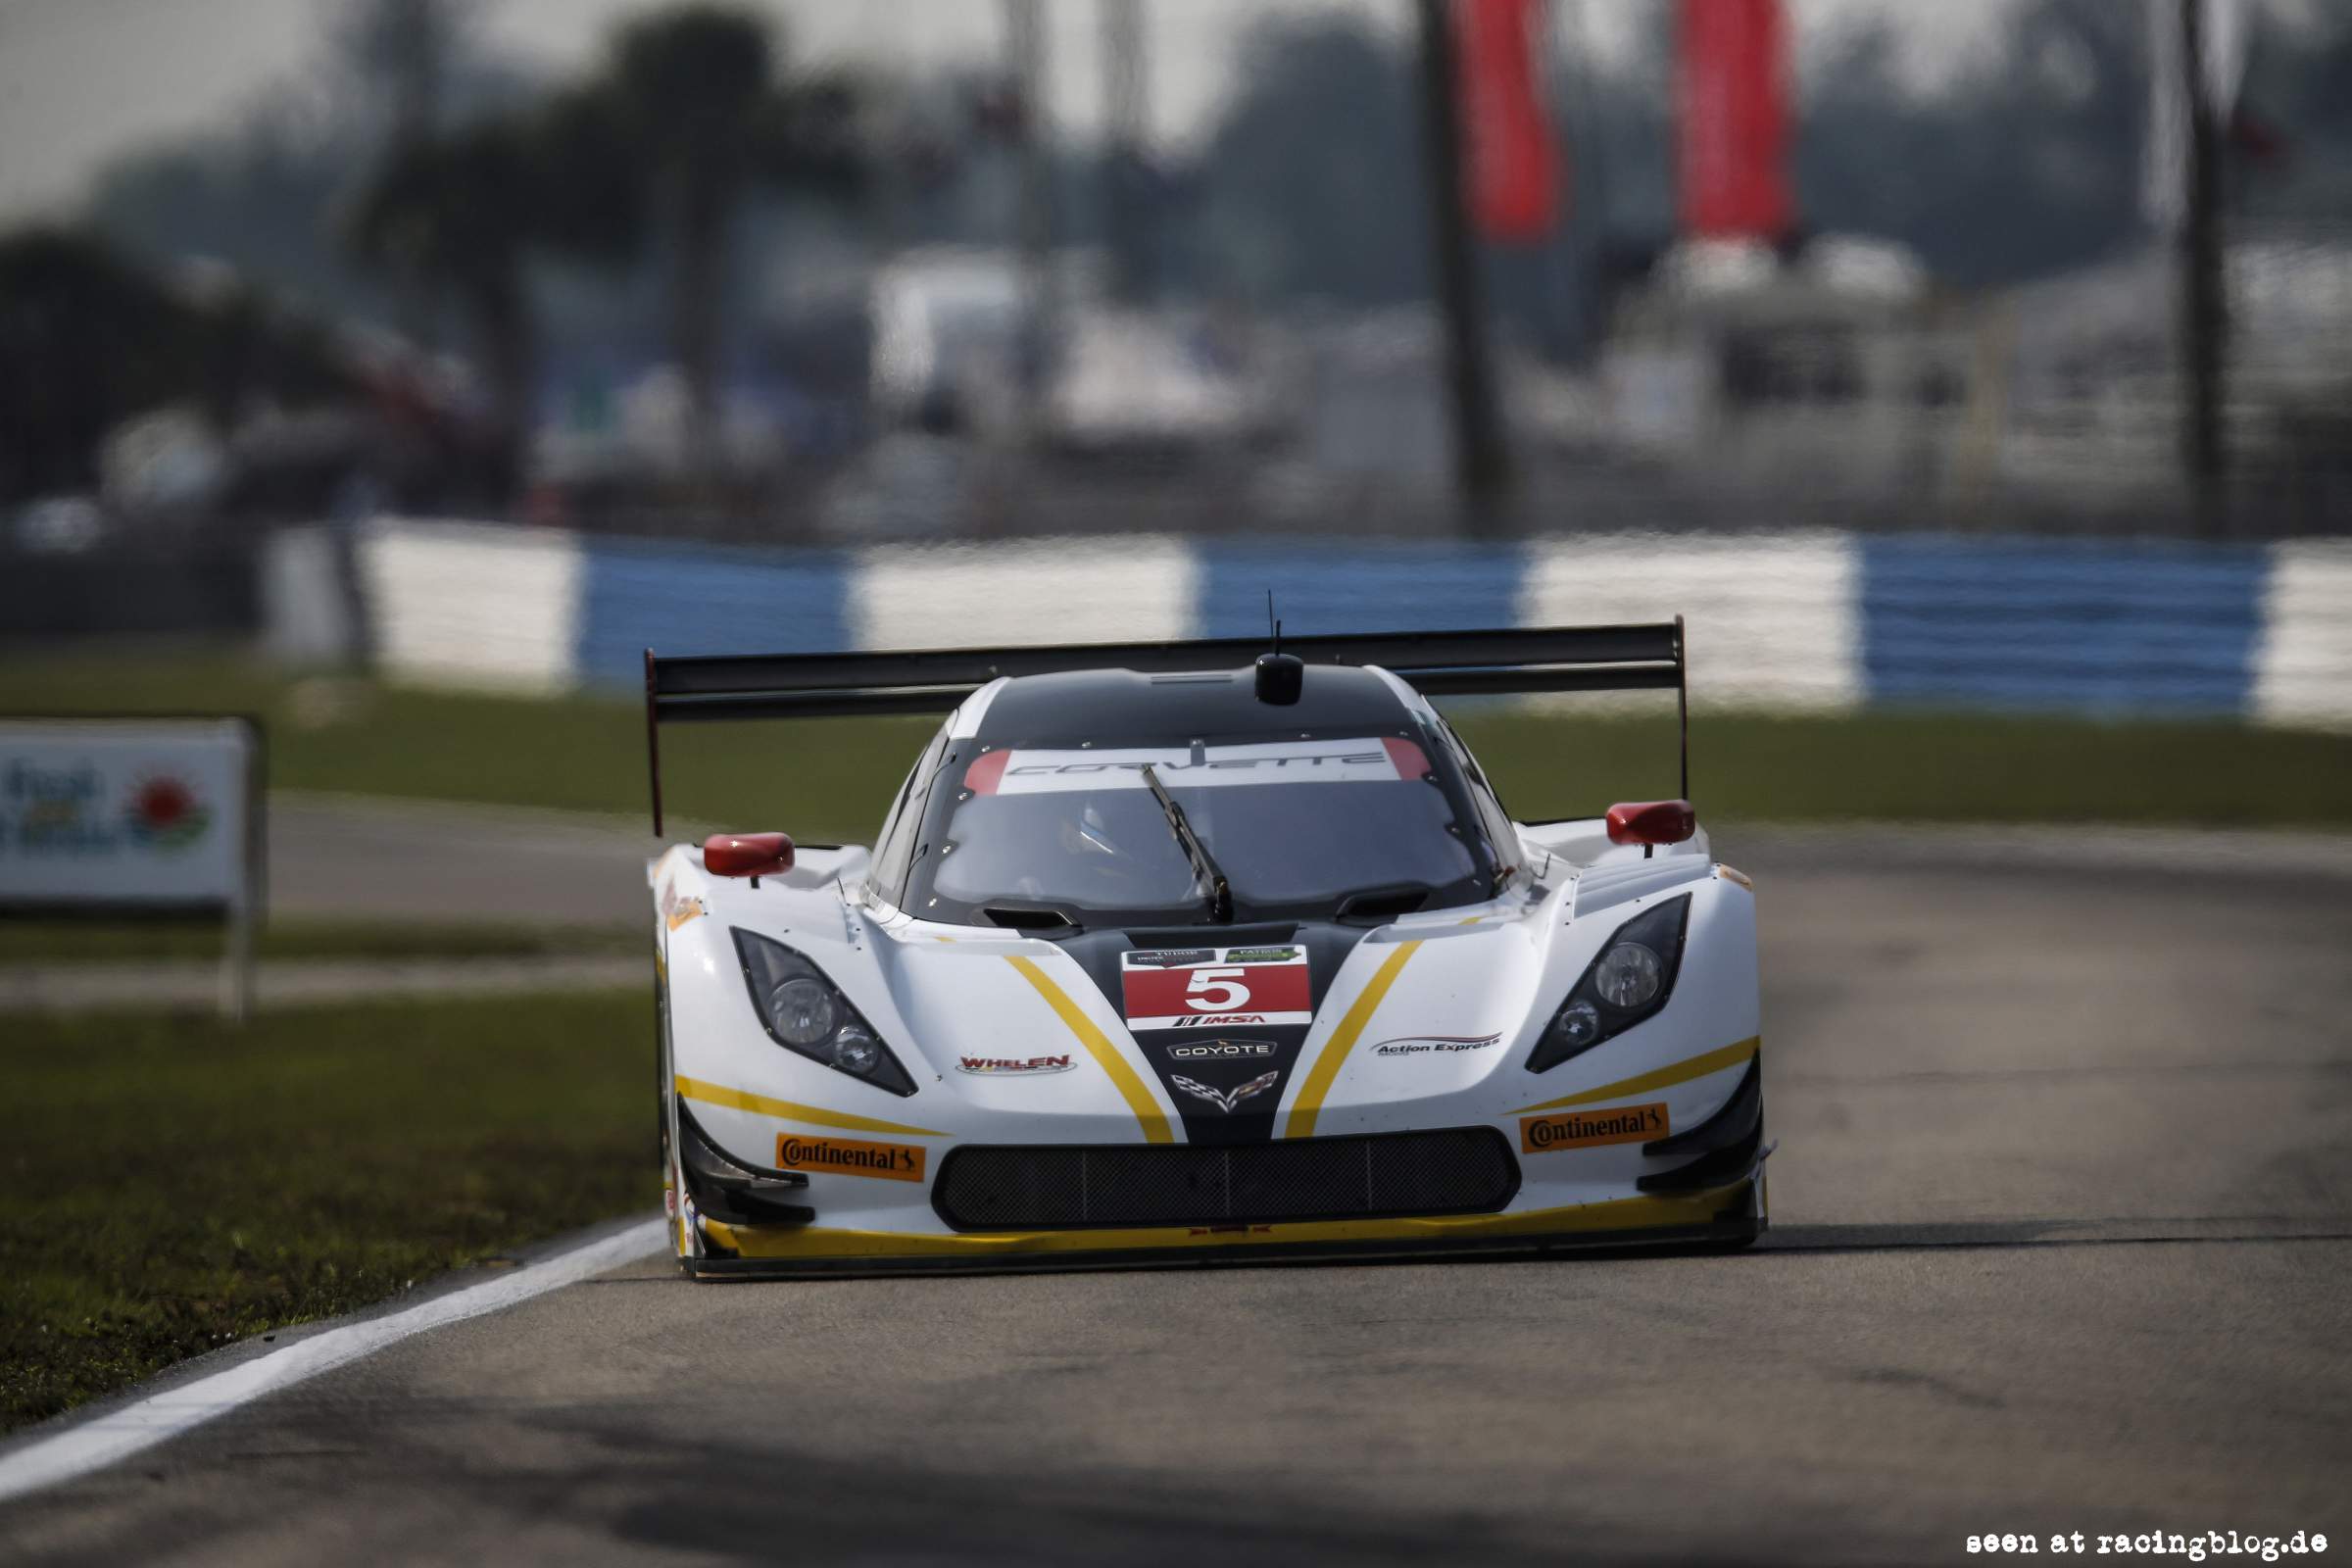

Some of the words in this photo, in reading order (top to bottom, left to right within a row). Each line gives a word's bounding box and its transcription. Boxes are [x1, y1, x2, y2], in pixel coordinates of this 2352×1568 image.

[1185, 968, 1250, 1010] 5
[1203, 1015, 1265, 1024] IMSA
[1176, 1045, 1270, 1055] COYOTE
[1434, 1038, 1499, 1052] Express
[960, 1054, 1070, 1068] WHELEN
[1529, 1111, 1645, 1148] Continental
[782, 1139, 895, 1169] Continental
